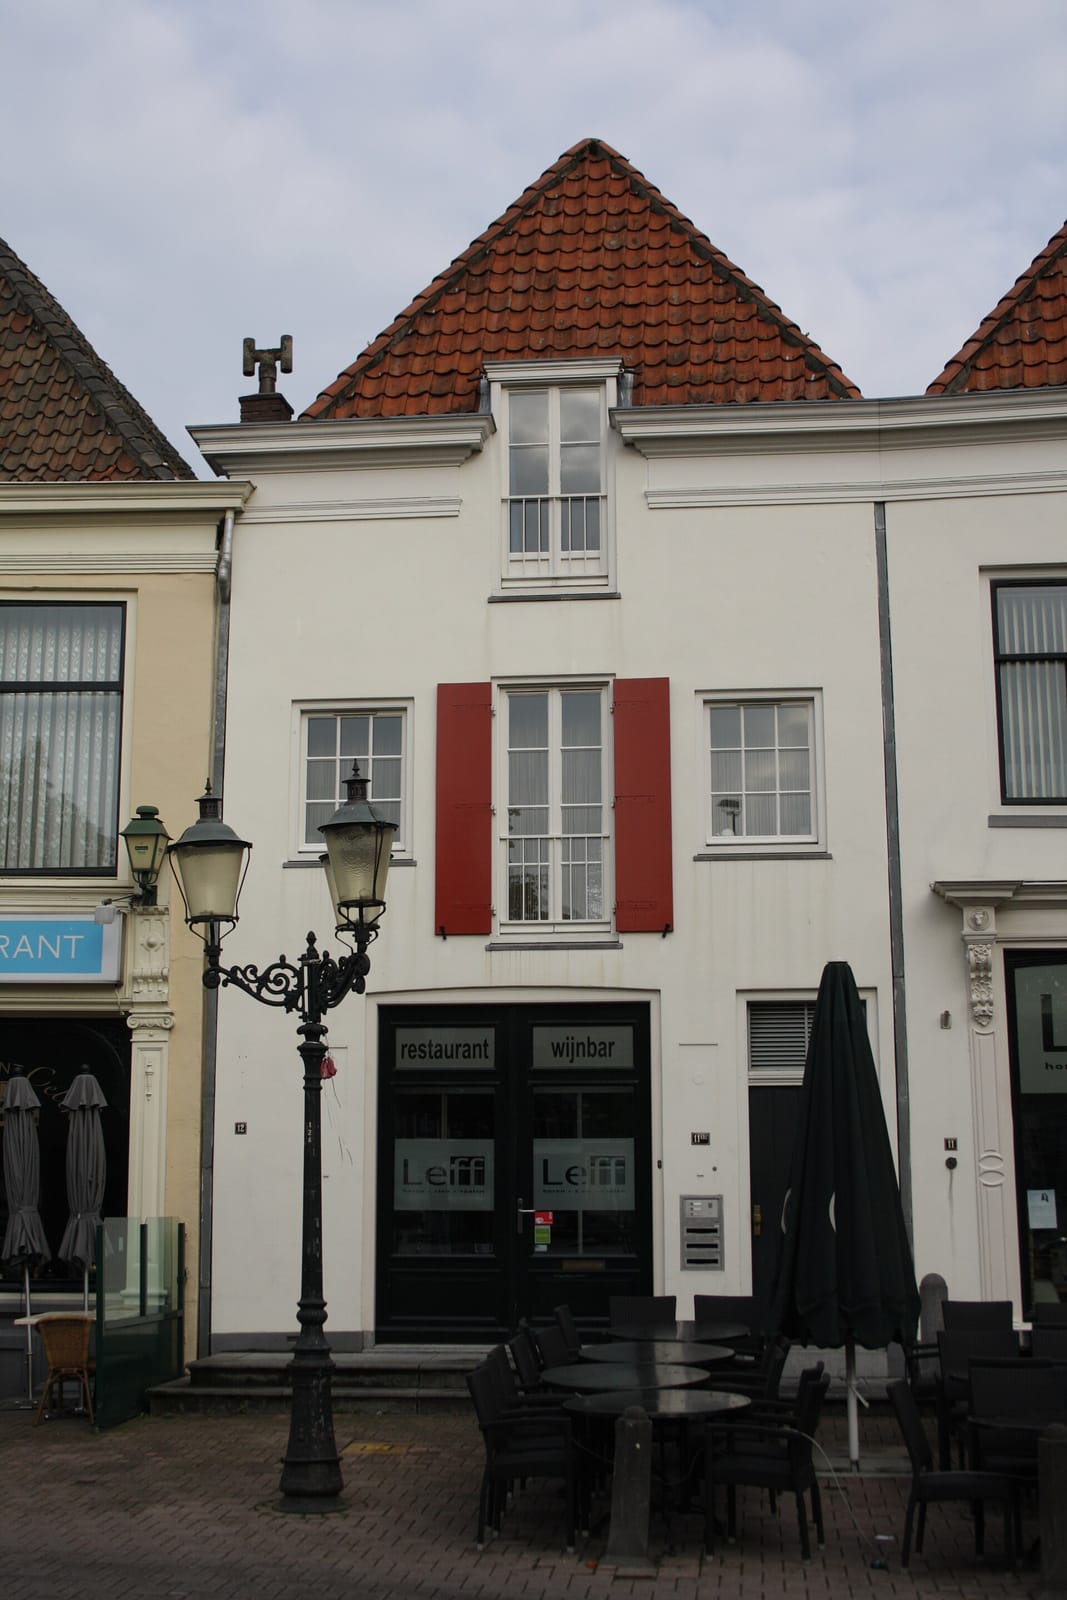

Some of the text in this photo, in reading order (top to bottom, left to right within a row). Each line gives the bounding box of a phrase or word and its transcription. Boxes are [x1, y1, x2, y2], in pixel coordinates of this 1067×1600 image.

[0, 934, 85, 959] RANT
[401, 1038, 489, 1060] restaurant
[551, 1036, 615, 1063] wijnbar
[237, 1123, 245, 1133] 12
